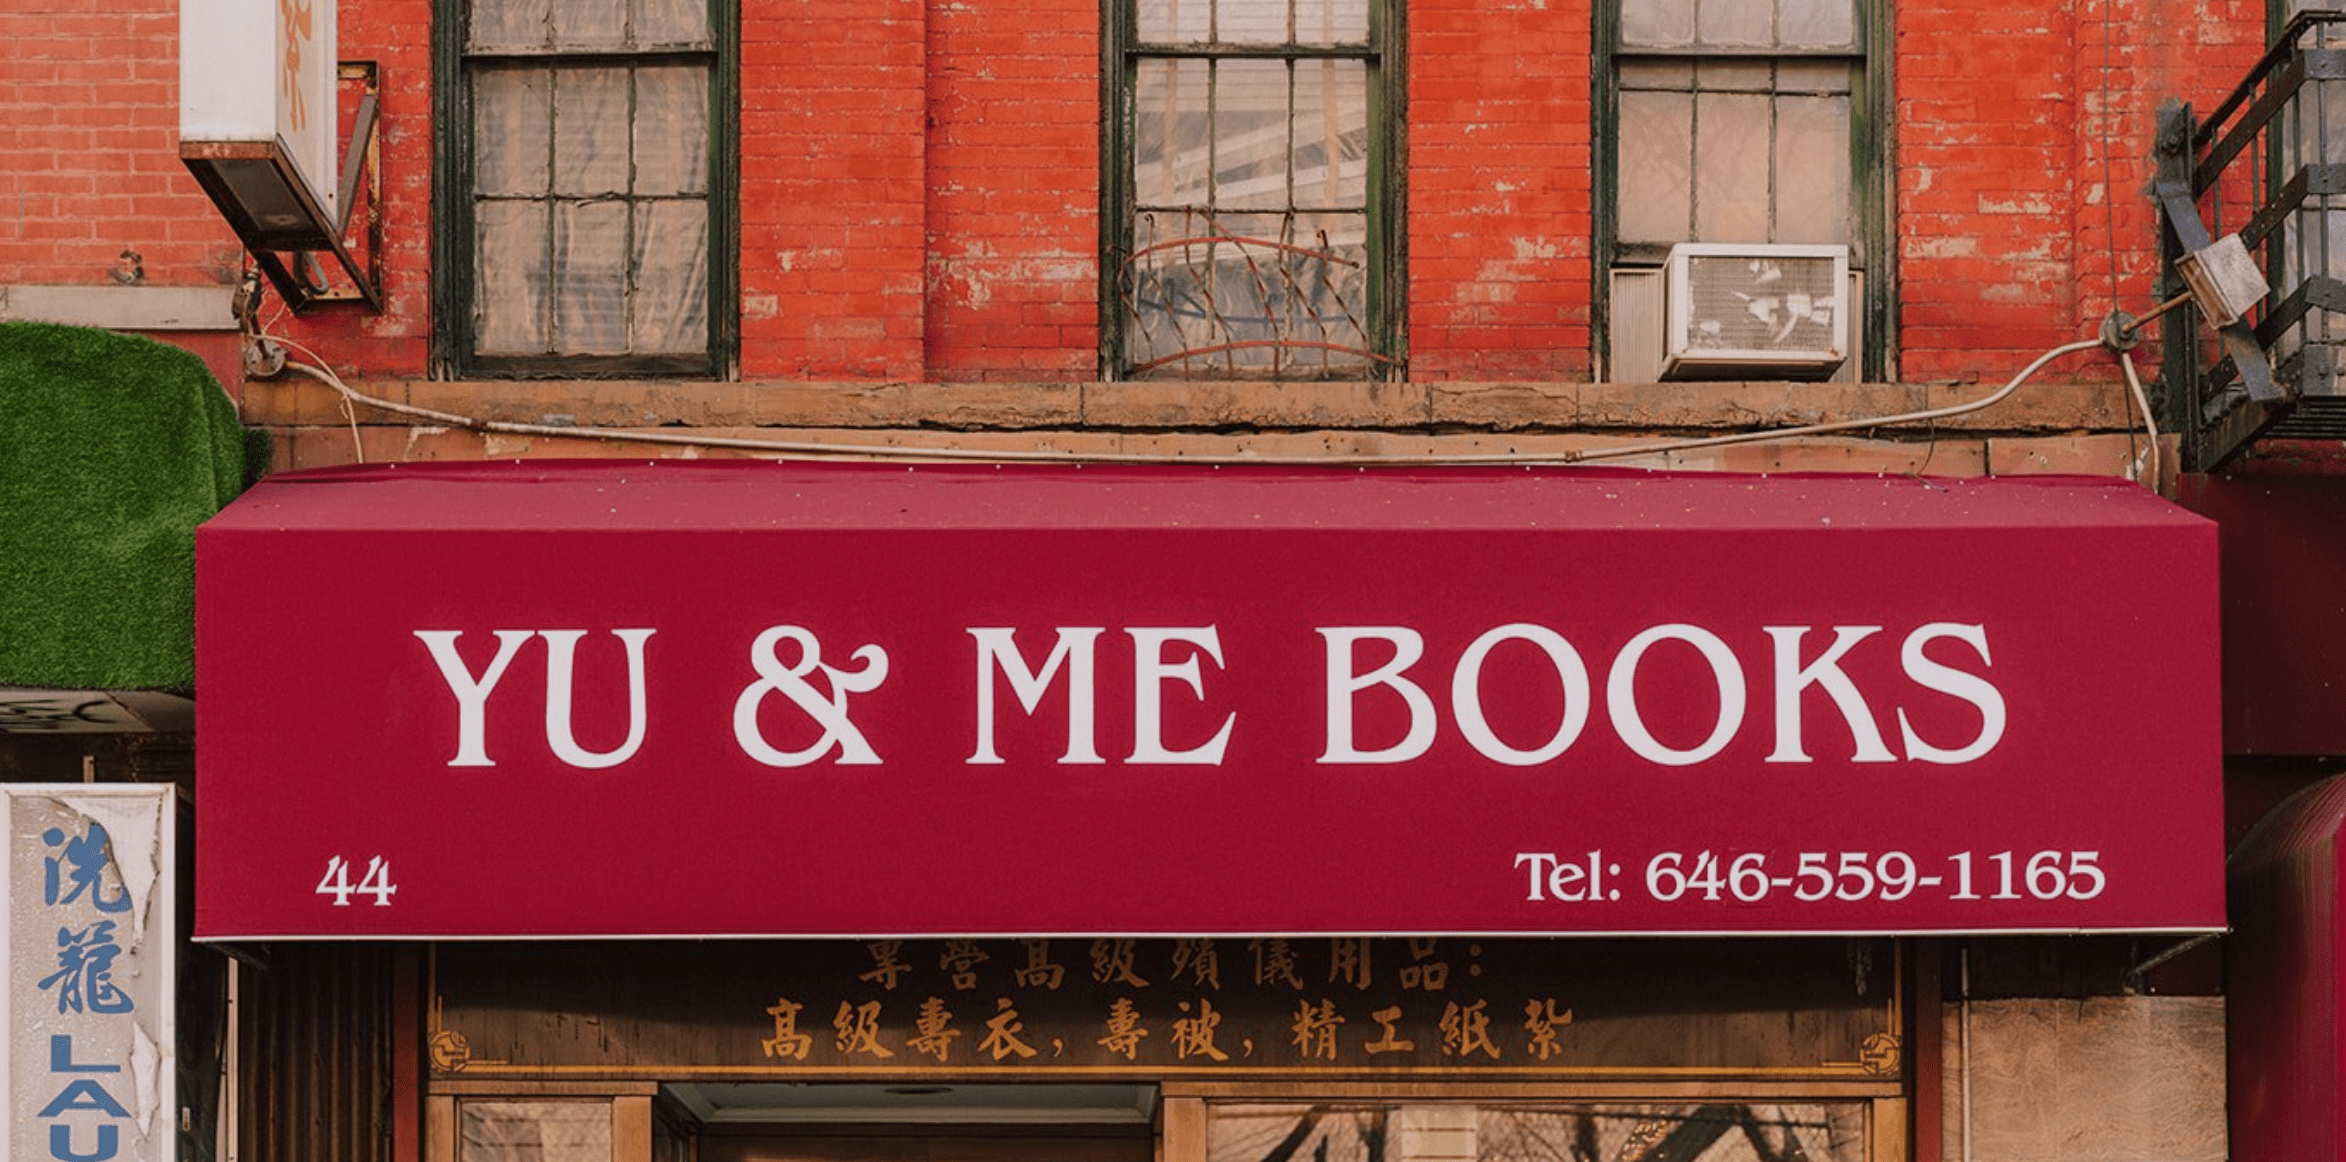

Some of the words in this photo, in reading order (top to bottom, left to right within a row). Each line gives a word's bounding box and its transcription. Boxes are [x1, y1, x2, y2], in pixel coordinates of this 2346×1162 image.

[414, 628, 657, 769] YU
[733, 625, 889, 768] &
[966, 625, 1236, 766] ME
[1316, 623, 2006, 766] BOOKS
[315, 855, 397, 907] 44
[1514, 849, 1622, 901] Tel:
[1646, 849, 2106, 902] 646-559-1165
